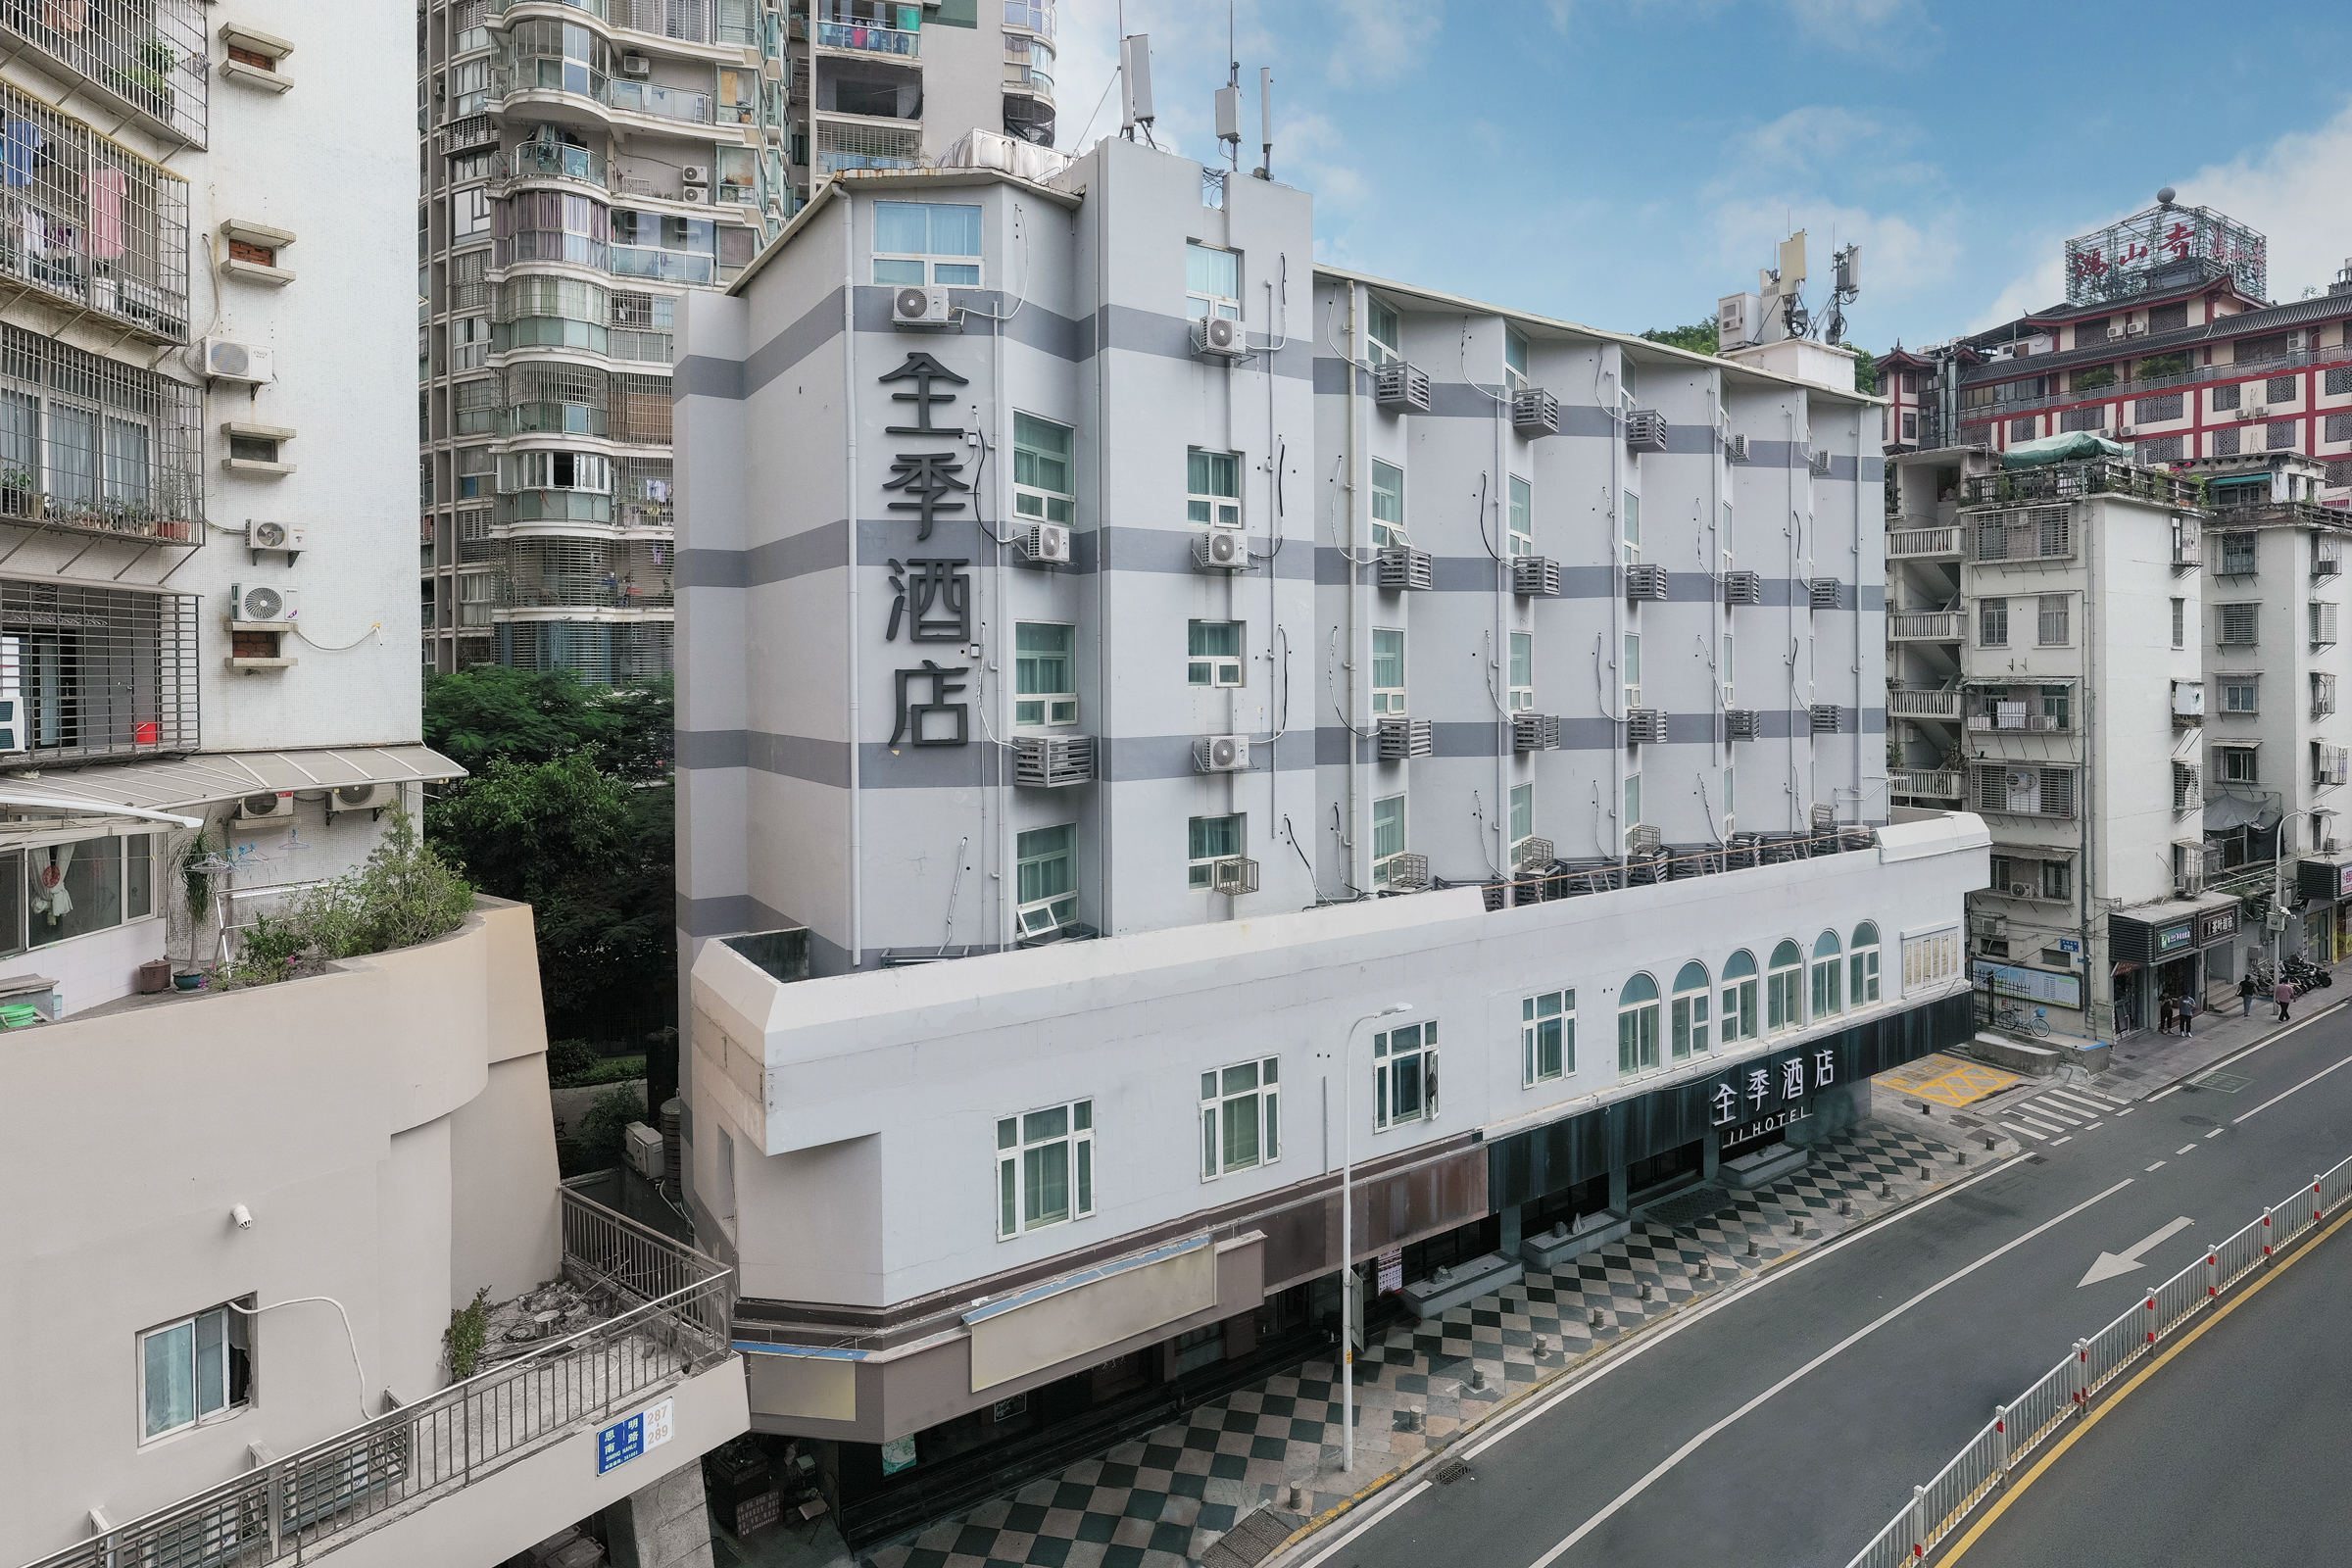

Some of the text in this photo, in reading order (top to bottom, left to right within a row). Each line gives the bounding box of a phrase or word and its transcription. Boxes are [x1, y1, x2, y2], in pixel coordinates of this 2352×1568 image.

[878, 352, 970, 747] 全季酒店
[1710, 1049, 1834, 1127] 全季酒店
[1752, 1105, 1809, 1137] HOTEL
[647, 1404, 668, 1426] 287
[647, 1424, 668, 1446] 289
